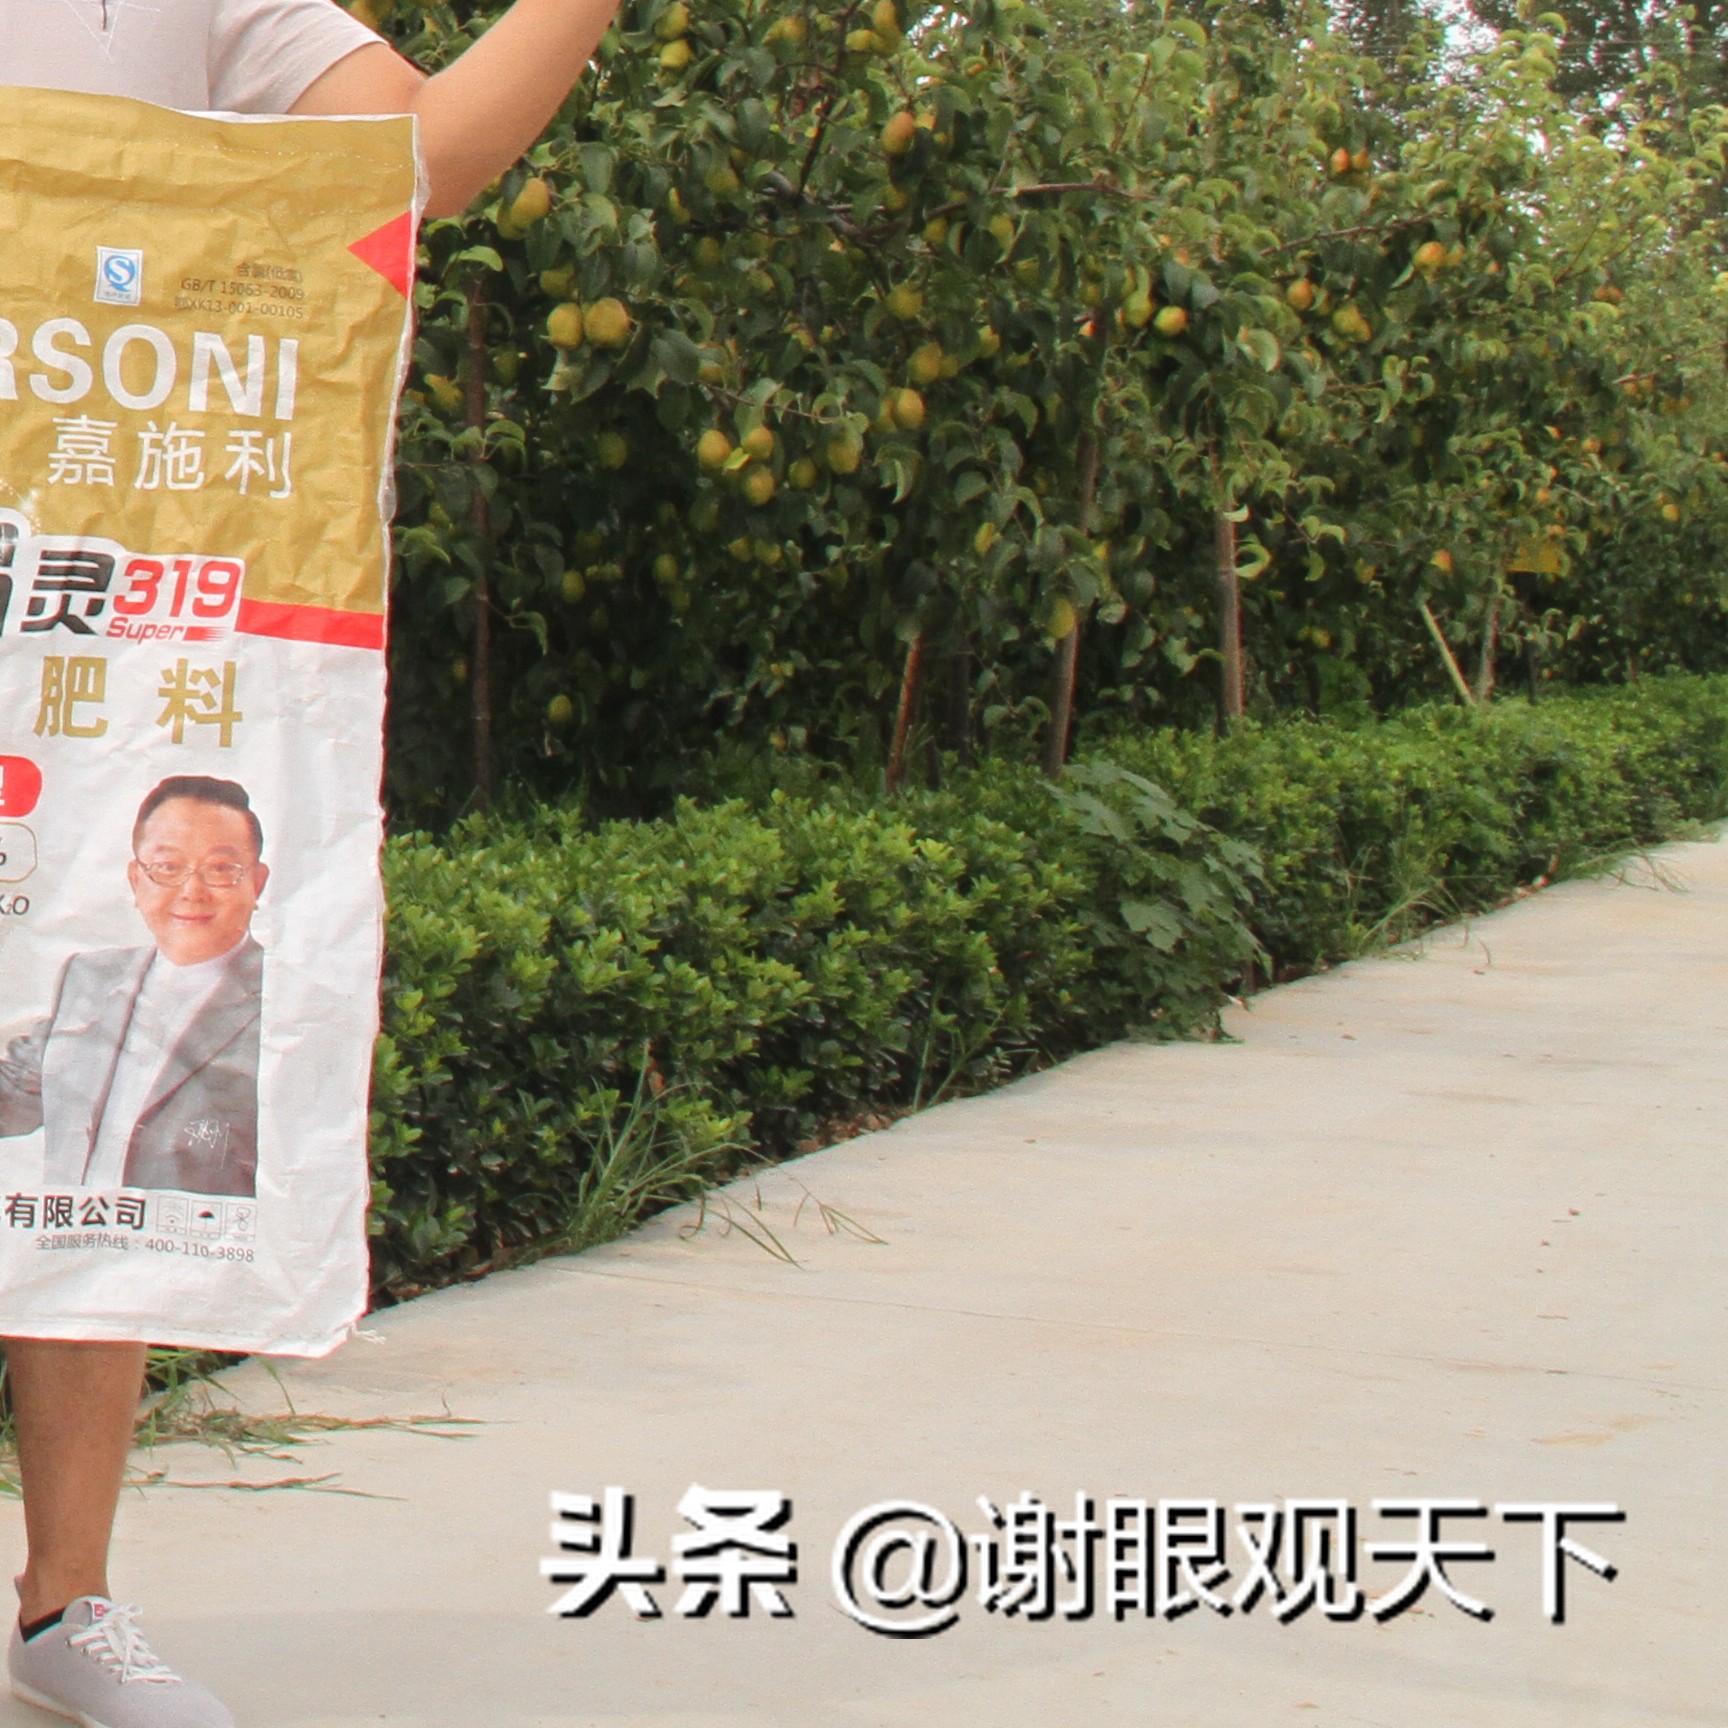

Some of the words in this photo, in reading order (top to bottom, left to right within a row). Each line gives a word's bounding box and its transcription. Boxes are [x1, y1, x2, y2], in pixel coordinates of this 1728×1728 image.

[47, 414, 292, 499] 嘉施利
[113, 559, 241, 620] 319
[106, 615, 183, 642] Super
